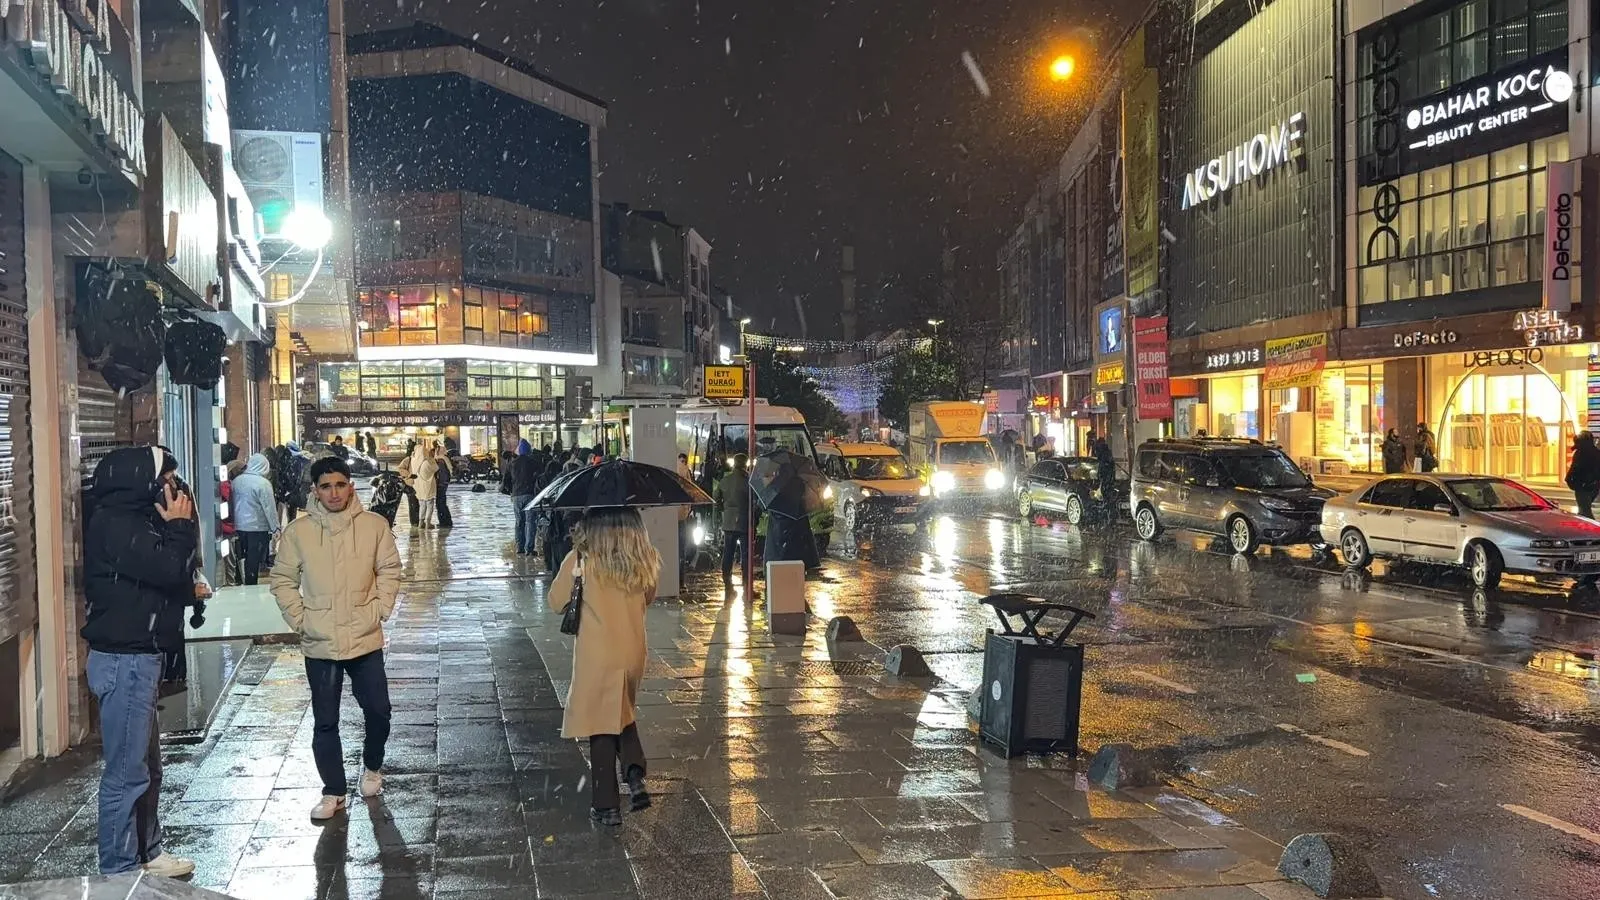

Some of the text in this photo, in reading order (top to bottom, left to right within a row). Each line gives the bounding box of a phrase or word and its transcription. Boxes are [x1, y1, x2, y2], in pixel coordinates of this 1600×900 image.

[1422, 86, 1489, 126] BAHAR
[1427, 107, 1528, 147] BEAUTY CENTER
[1552, 193, 1572, 281] DeFacto
[1393, 329, 1457, 348] DeFacto
